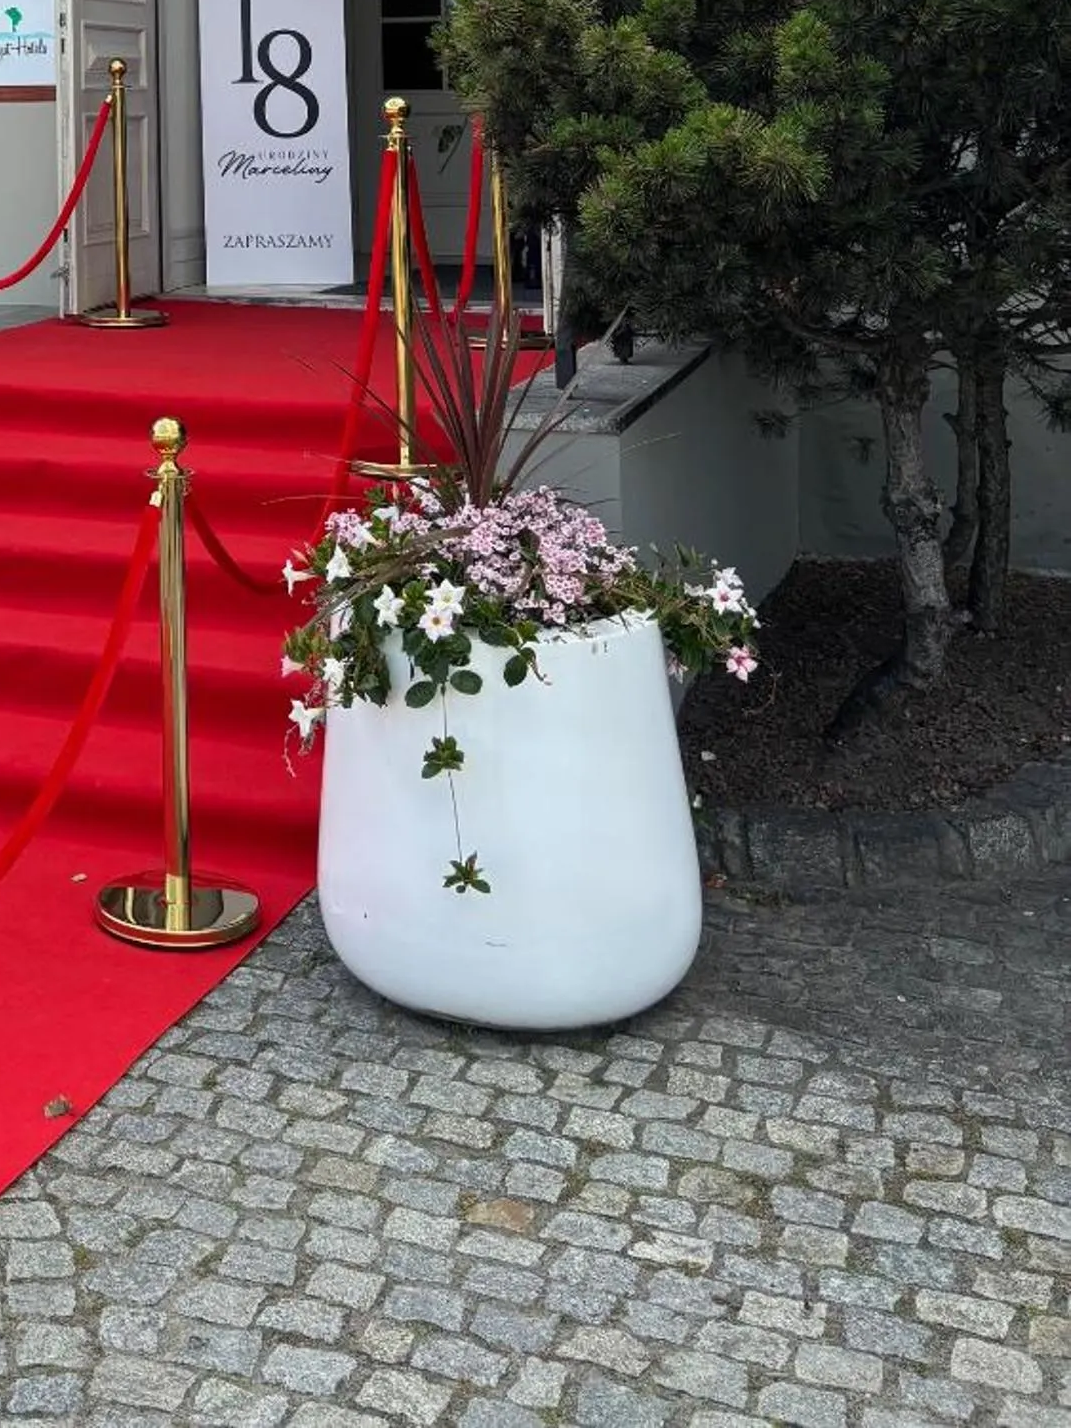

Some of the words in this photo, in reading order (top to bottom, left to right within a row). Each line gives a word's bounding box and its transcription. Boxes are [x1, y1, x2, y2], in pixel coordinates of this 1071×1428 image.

[258, 149, 330, 161] URODZINY
[217, 150, 334, 184] Marceliny
[223, 233, 334, 249] ZAPRASZAMY
